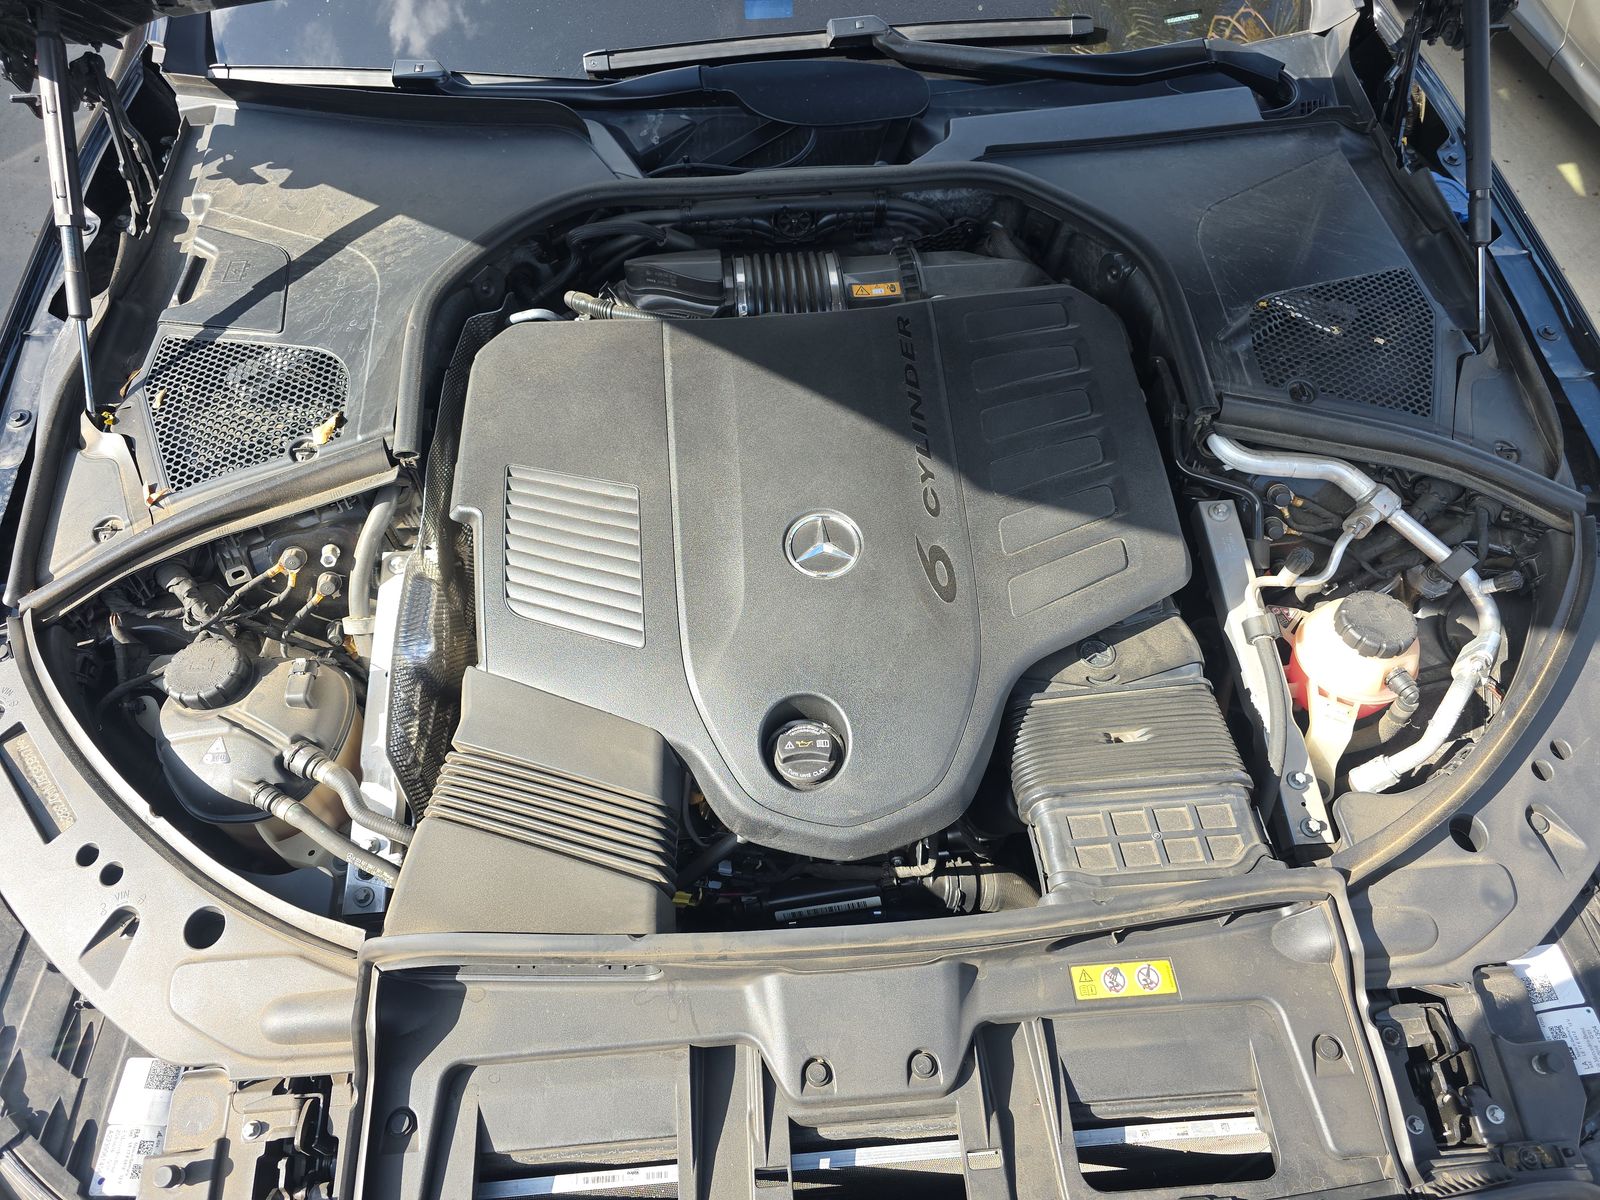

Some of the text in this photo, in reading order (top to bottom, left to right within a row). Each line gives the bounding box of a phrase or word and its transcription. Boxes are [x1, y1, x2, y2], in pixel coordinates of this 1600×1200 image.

[897, 315, 957, 603] 6 CYLINDER
[812, 766, 828, 777] CLICK
[114, 889, 130, 900] VIN
